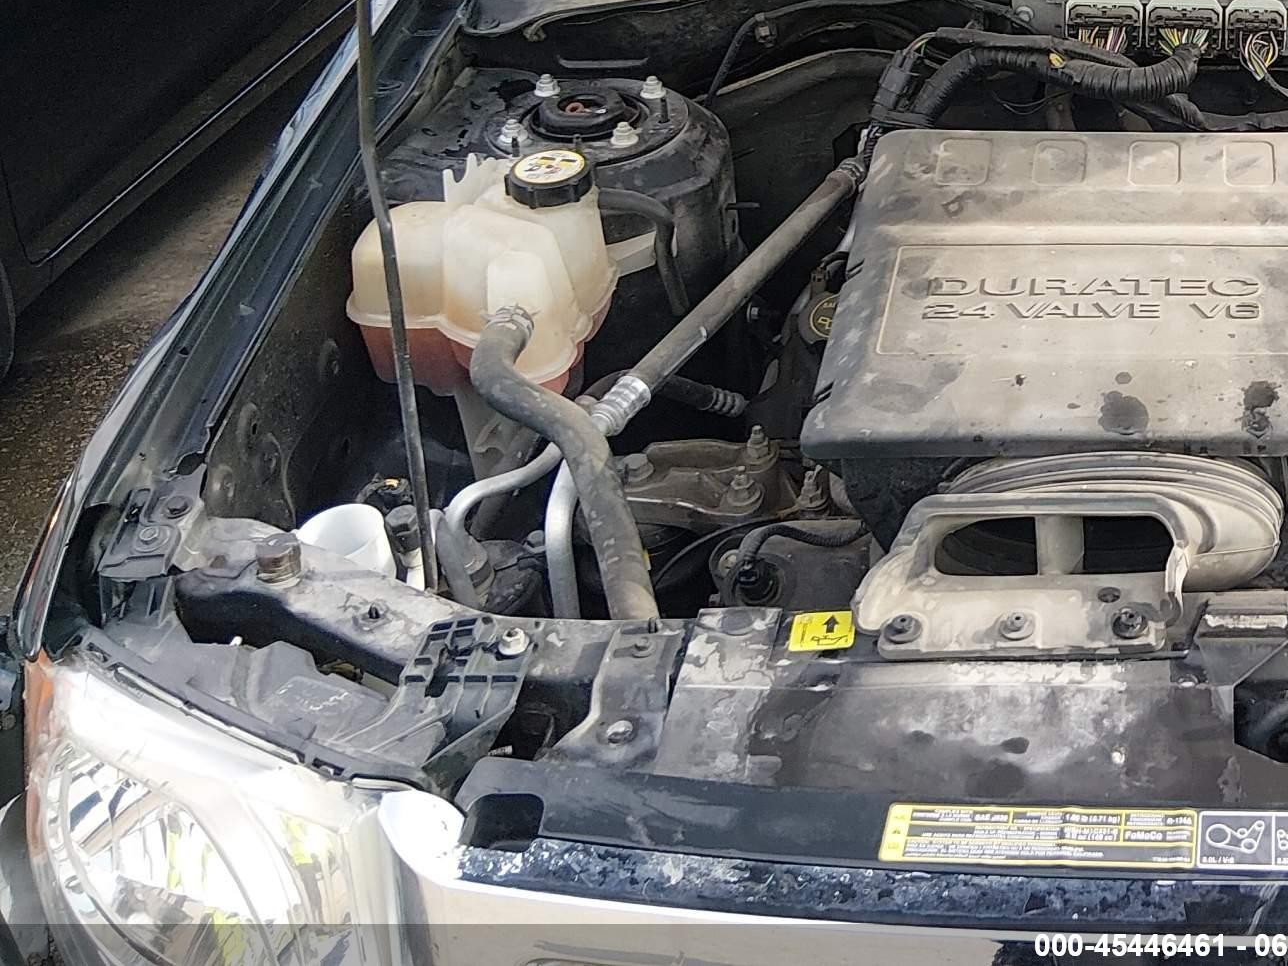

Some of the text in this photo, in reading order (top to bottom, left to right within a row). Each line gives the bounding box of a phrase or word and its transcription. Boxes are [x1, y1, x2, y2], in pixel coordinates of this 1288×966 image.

[926, 276, 1260, 297] DURATEC
[921, 302, 1261, 320] 24 VALVE V6
